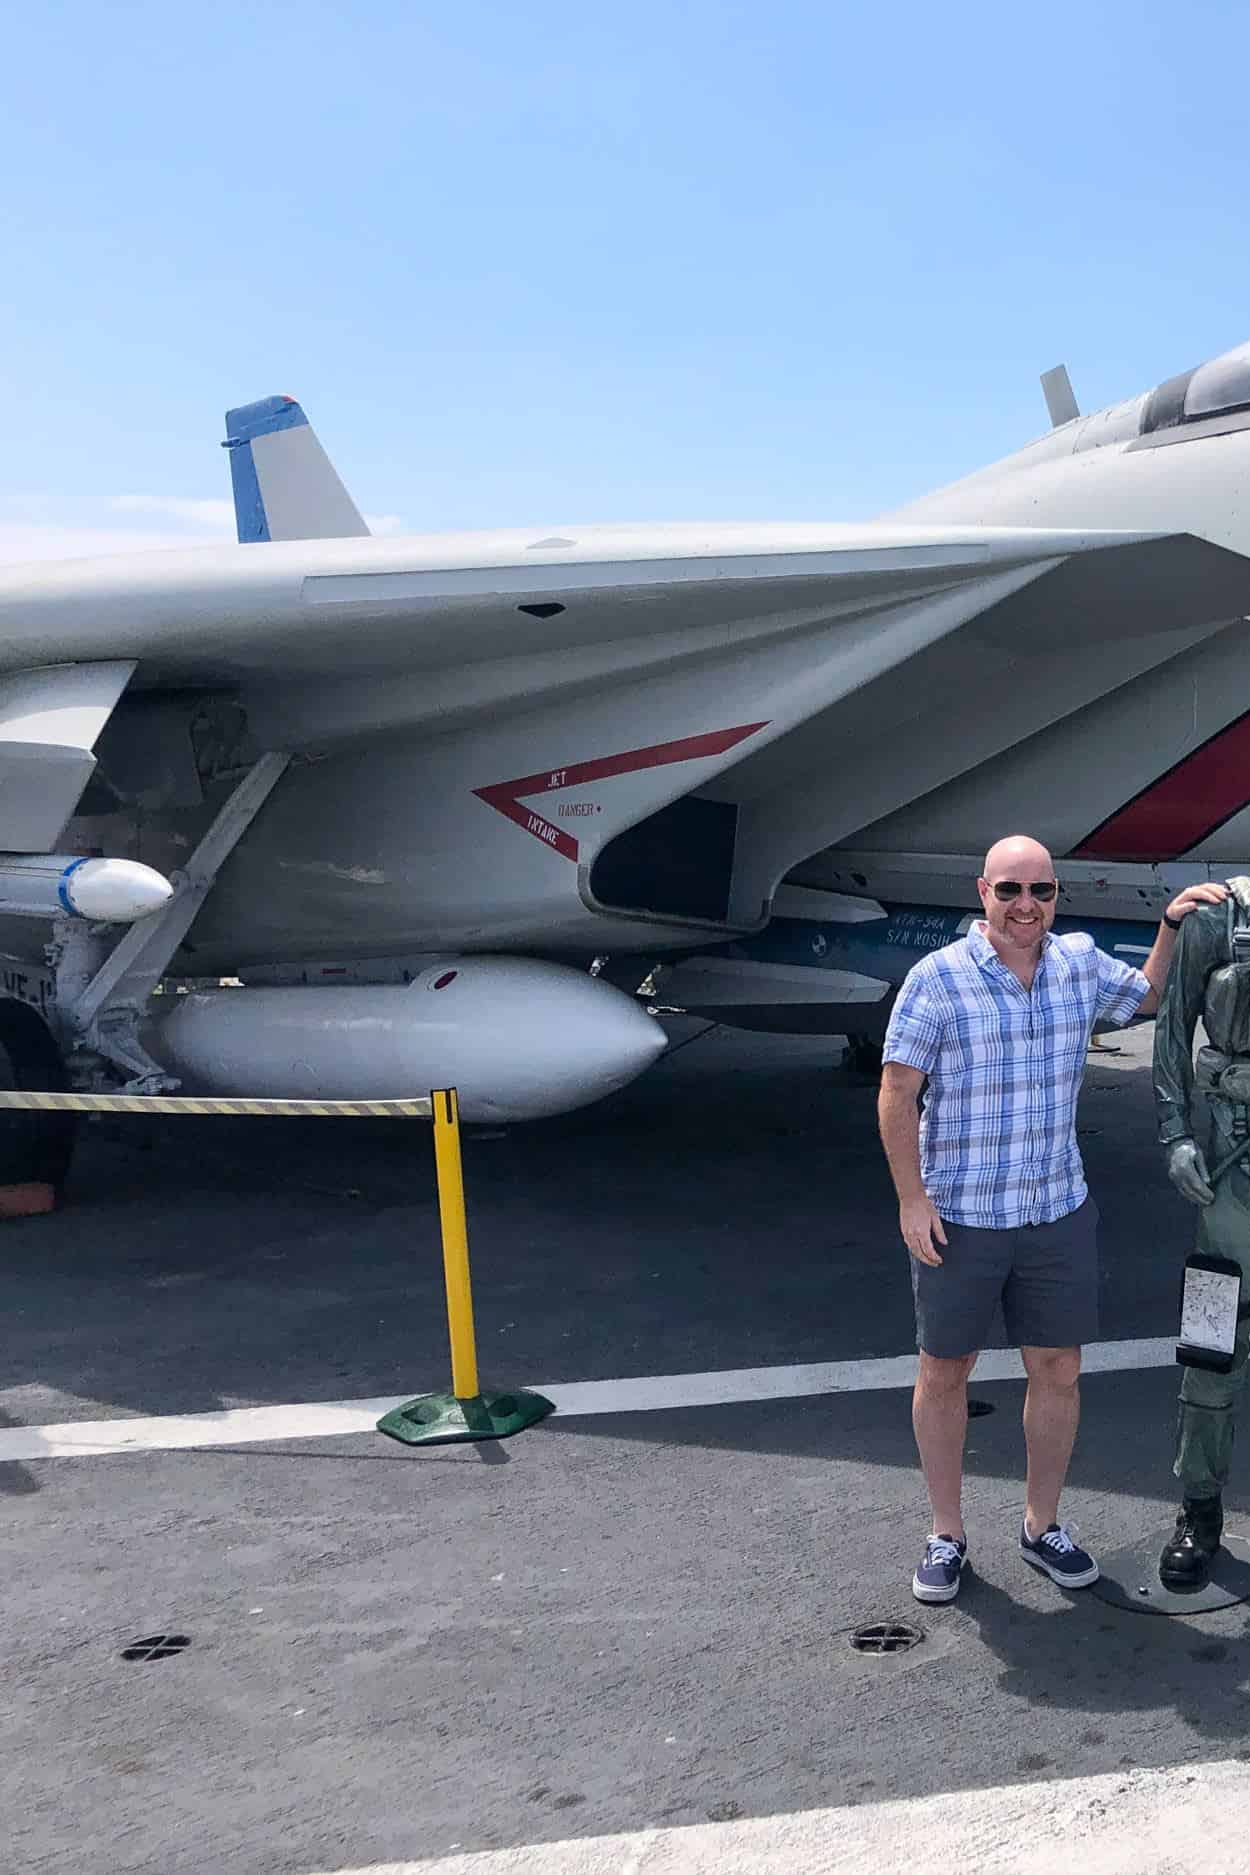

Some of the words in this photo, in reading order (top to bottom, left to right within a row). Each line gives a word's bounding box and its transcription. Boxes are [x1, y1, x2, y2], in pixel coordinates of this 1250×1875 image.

[547, 771, 568, 787] JET
[558, 803, 594, 817] DANGER
[527, 815, 561, 846] INTAKE
